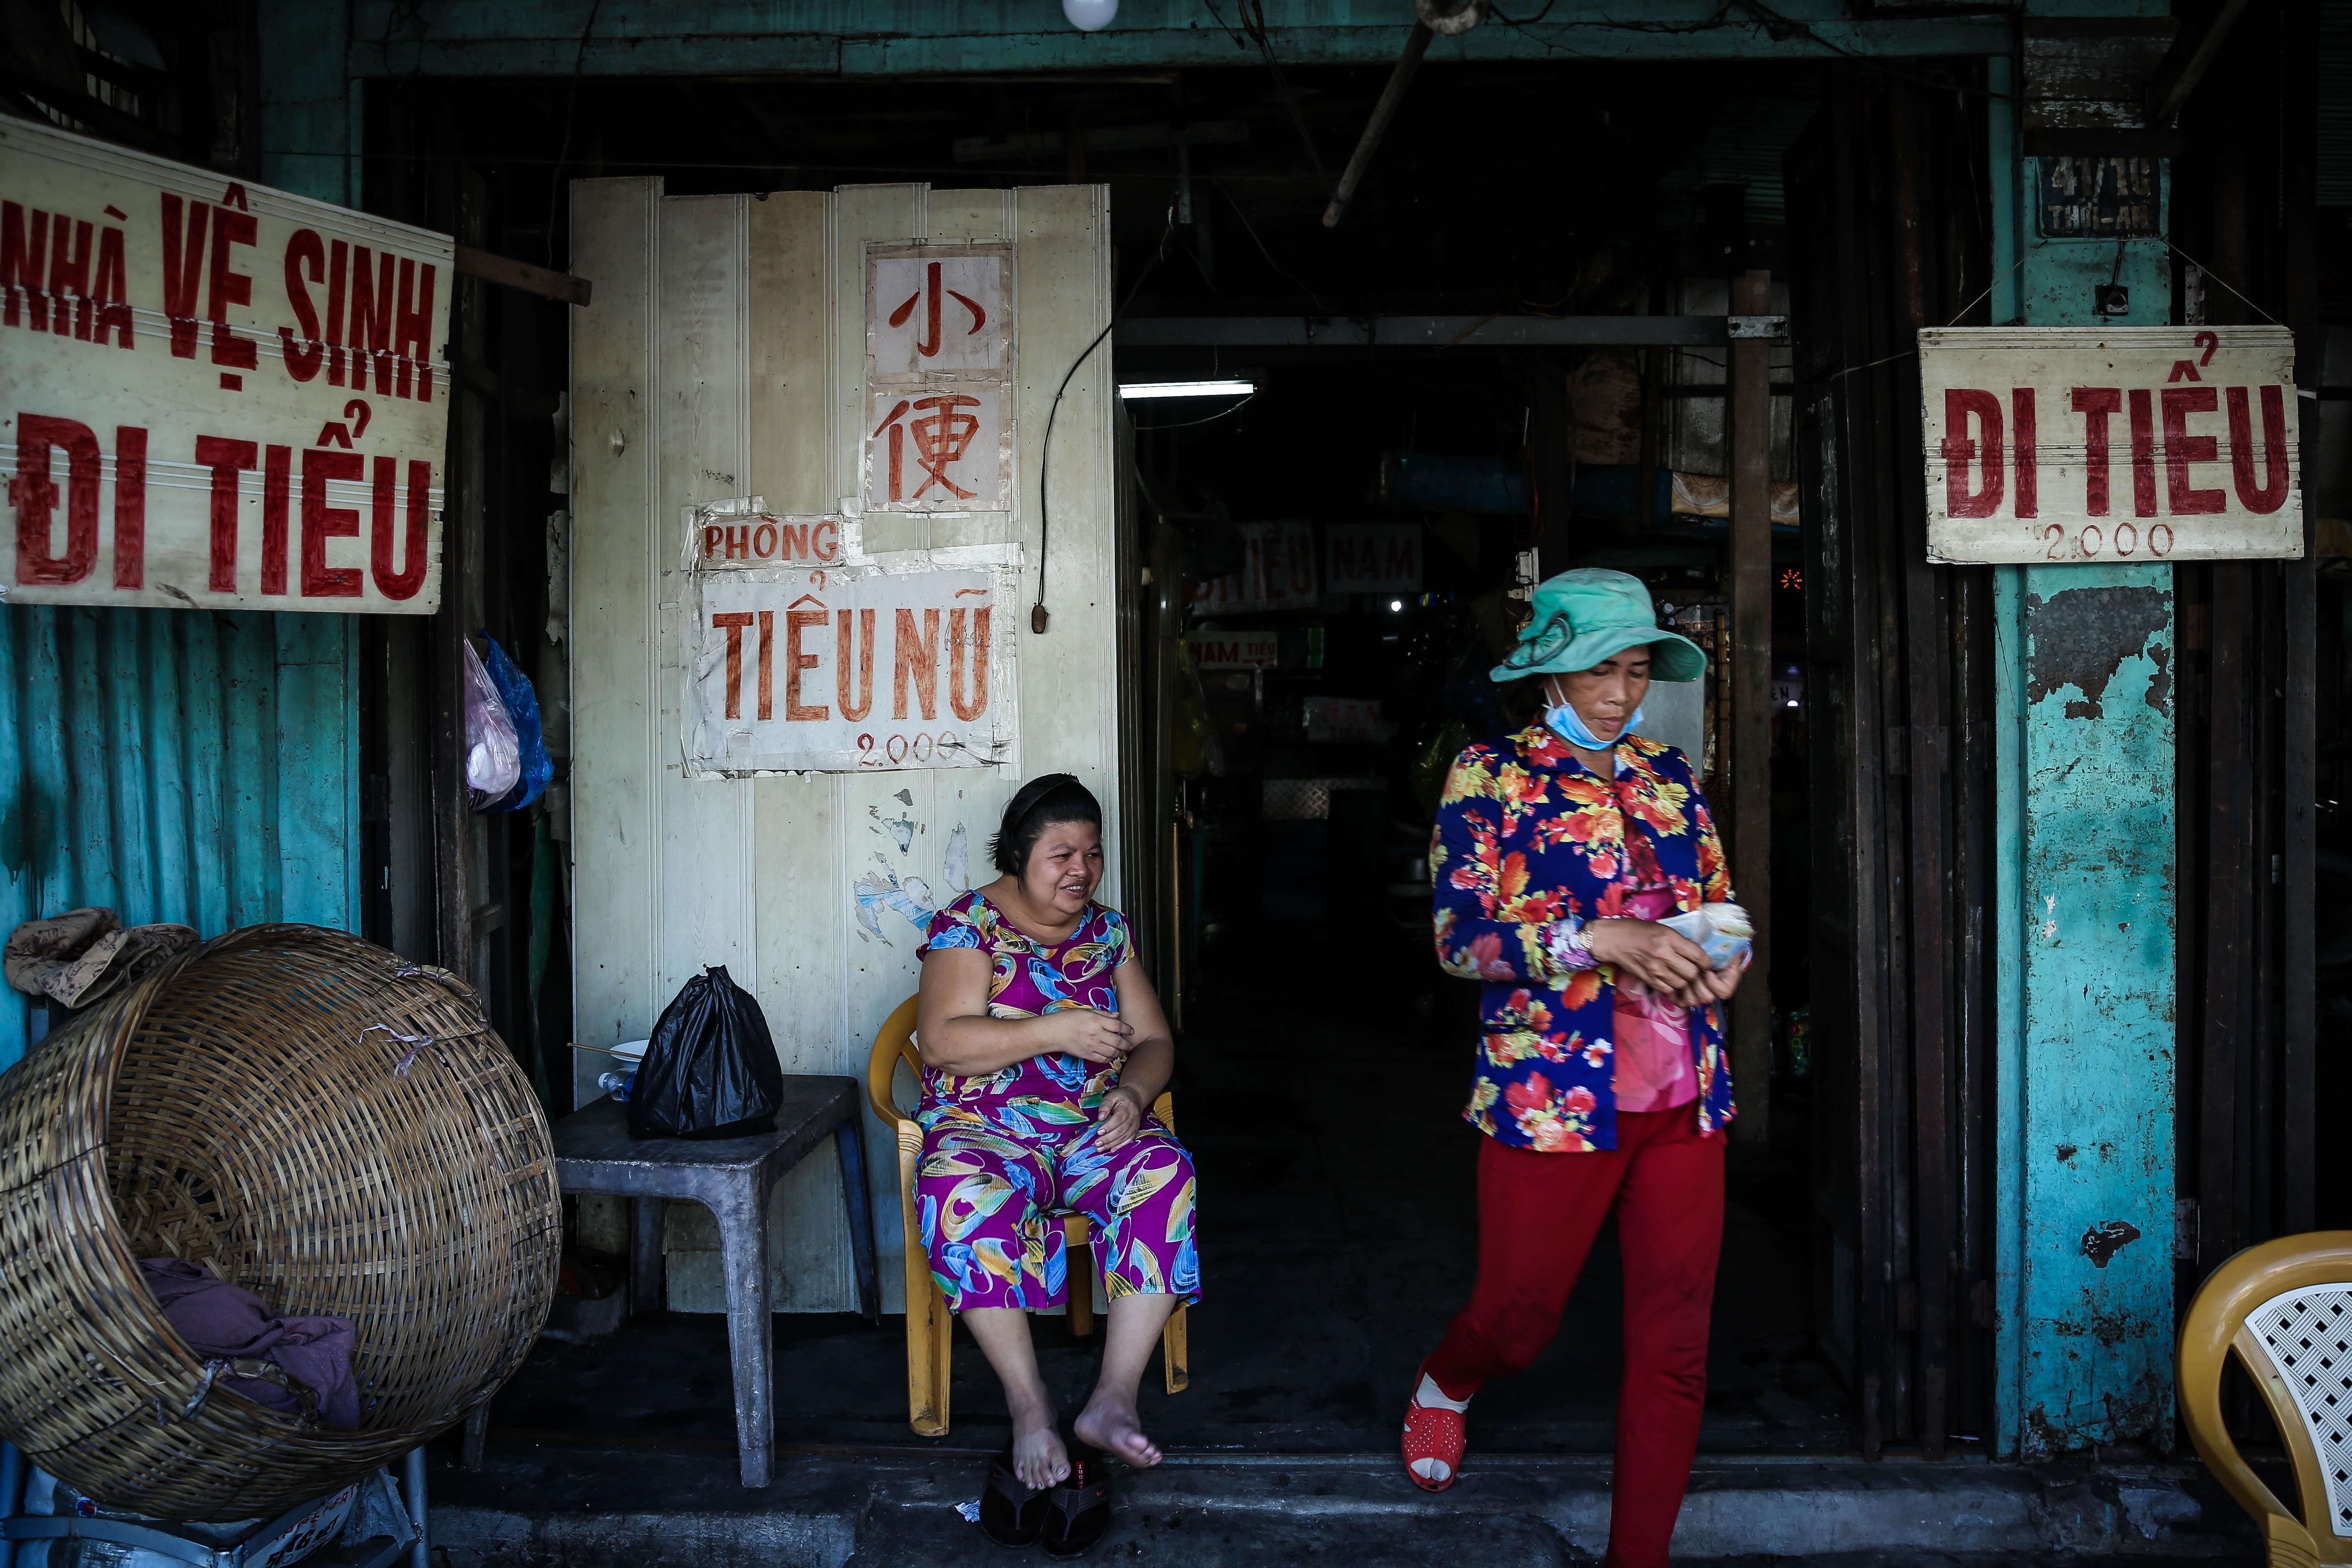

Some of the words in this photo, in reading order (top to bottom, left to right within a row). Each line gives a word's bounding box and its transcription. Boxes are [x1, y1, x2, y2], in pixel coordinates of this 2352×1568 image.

[2, 200, 134, 350] NHÀ
[161, 183, 258, 392] VỆ
[278, 229, 436, 403] SINH
[873, 261, 986, 502] 小便
[1941, 387, 2038, 519] ĐI
[2071, 331, 2290, 518] TIỂU
[9, 412, 148, 590] ĐI
[195, 399, 430, 601] TIỂU
[704, 516, 839, 561] PHÒNG
[2044, 522, 2175, 561] 2.000
[1332, 537, 1414, 581] NAM
[712, 570, 876, 722] TIỂU
[892, 588, 996, 722] NỮ
[1189, 641, 1239, 663] NAM
[857, 731, 959, 767] 2.000
